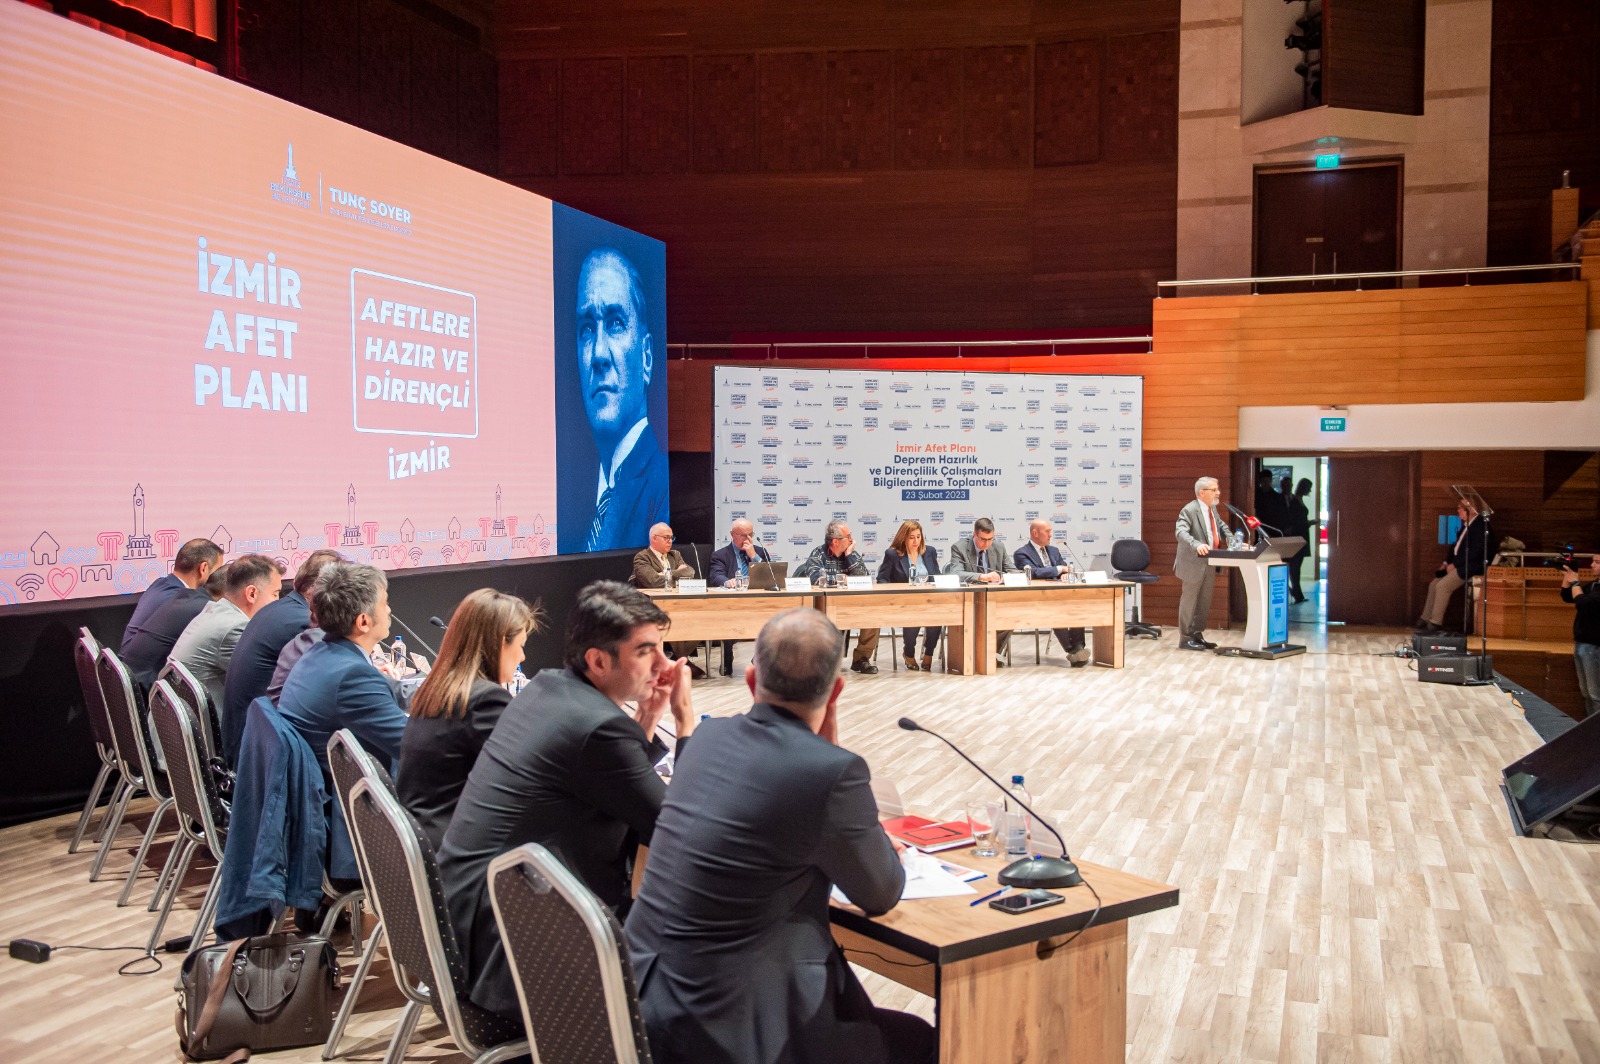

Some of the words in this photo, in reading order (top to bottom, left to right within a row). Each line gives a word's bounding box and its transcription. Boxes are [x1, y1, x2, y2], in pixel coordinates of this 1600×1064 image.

[328, 187, 367, 215] TUNÇ
[370, 200, 412, 224] SOYER
[197, 236, 302, 309] İZMİR
[204, 309, 298, 360] AFET
[360, 298, 470, 338] AFETLERE
[365, 336, 436, 369] HAZIR
[441, 348, 469, 373] VE
[194, 363, 308, 413] PLANI
[364, 369, 470, 411] DİRENÇLİ
[388, 439, 450, 480] İZMİR
[894, 455, 936, 466] Deprem
[939, 455, 978, 464] Hazırlık
[896, 441, 922, 452] İzmir
[924, 443, 947, 452] Afet
[950, 443, 976, 452] Planı
[873, 477, 944, 489] Bilgilendirme
[947, 477, 998, 488] Toplantısı
[885, 466, 938, 477] Dirençlilik
[941, 466, 1002, 477] Çalışmaları
[905, 491, 916, 499] 23
[918, 491, 943, 500] Şubat
[945, 491, 966, 499] 2023
